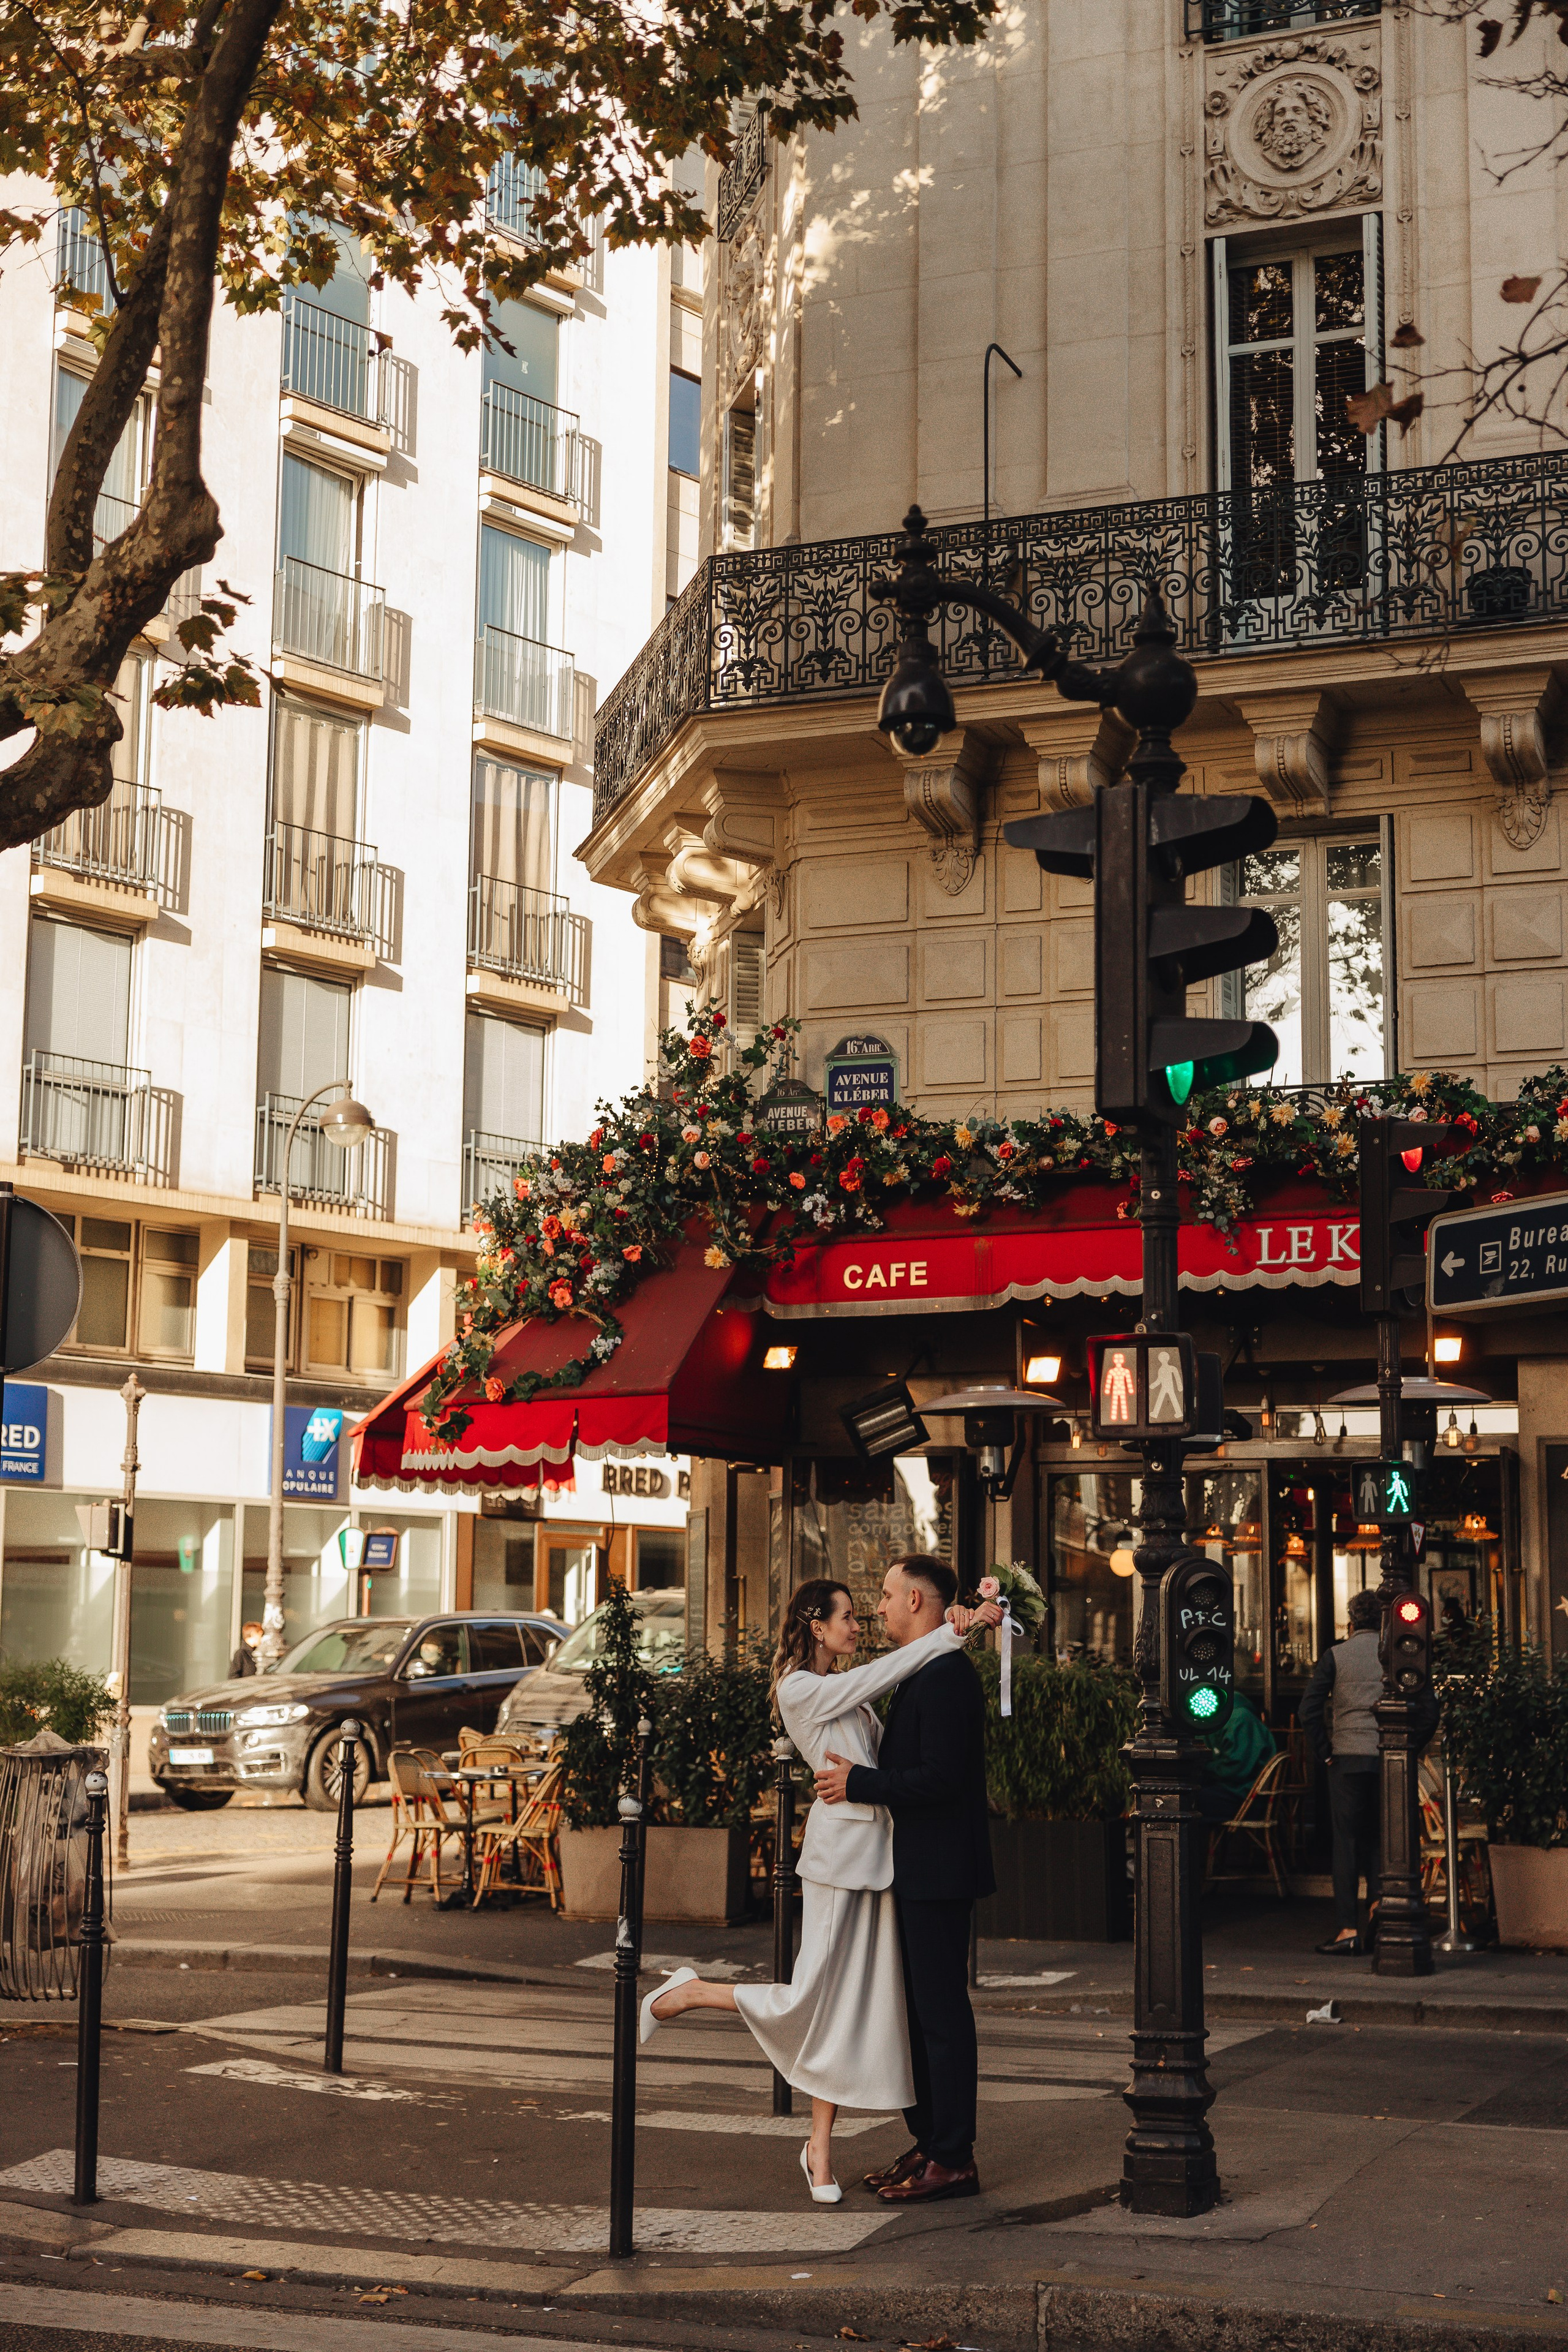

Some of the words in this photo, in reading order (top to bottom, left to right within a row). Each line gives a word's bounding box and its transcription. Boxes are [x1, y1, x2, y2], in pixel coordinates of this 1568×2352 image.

[835, 1072, 889, 1086] AVENUE
[834, 1087, 889, 1102] KLÉBER
[767, 1106, 808, 1119] AVENUE
[1256, 1226, 1316, 1265] LE
[1327, 1223, 1360, 1262] K
[1509, 1224, 1568, 1250] Burea
[843, 1261, 927, 1289] CAFE
[1509, 1259, 1534, 1280] 22,
[1545, 1254, 1567, 1274] Ru
[2, 1460, 39, 1474] FRANCE
[285, 1469, 335, 1481] ANQUE
[282, 1480, 334, 1494] OPULAIRE
[602, 1464, 663, 1494] BRED
[1207, 1666, 1232, 1684] 14
